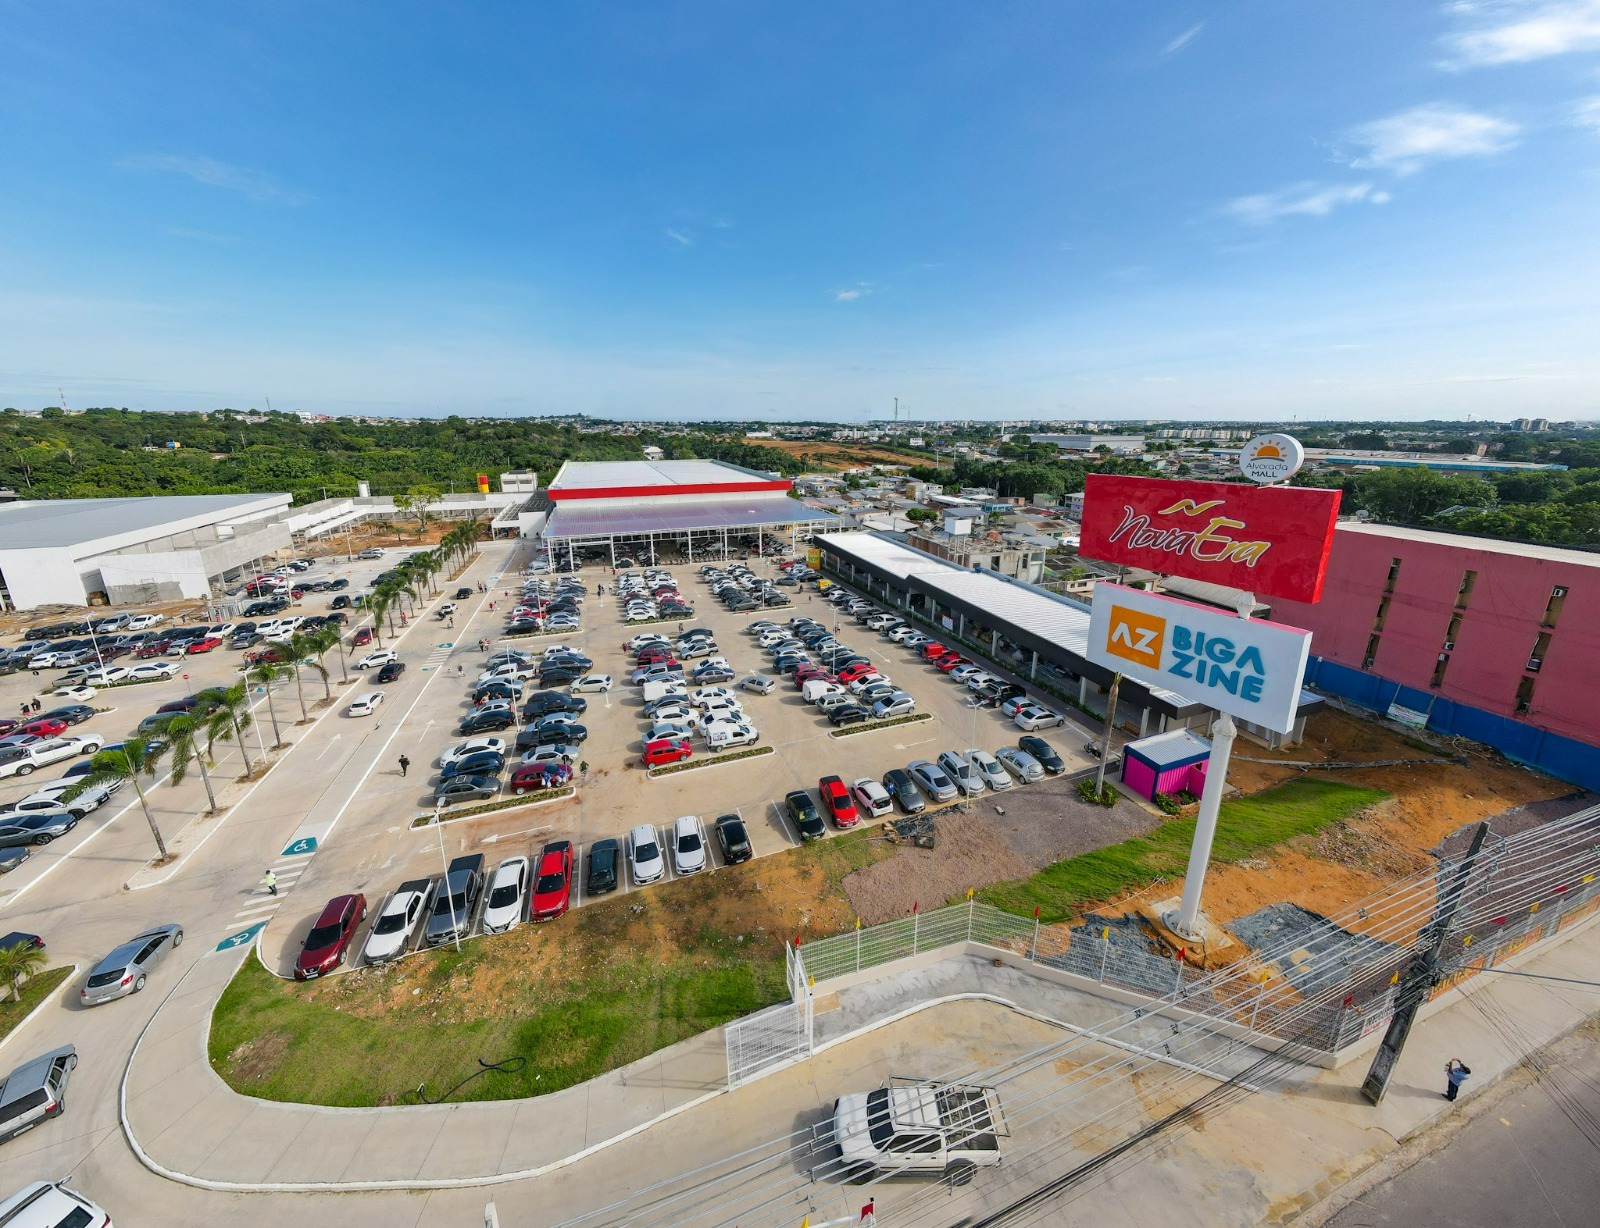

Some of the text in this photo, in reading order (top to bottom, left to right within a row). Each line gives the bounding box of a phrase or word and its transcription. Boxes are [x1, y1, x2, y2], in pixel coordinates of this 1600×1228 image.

[1245, 461, 1289, 472] Alvorada
[1251, 470, 1279, 479] MALL
[1111, 621, 1160, 656] AZ
[1171, 624, 1266, 675] BIGA
[1167, 649, 1265, 704] ZINE
